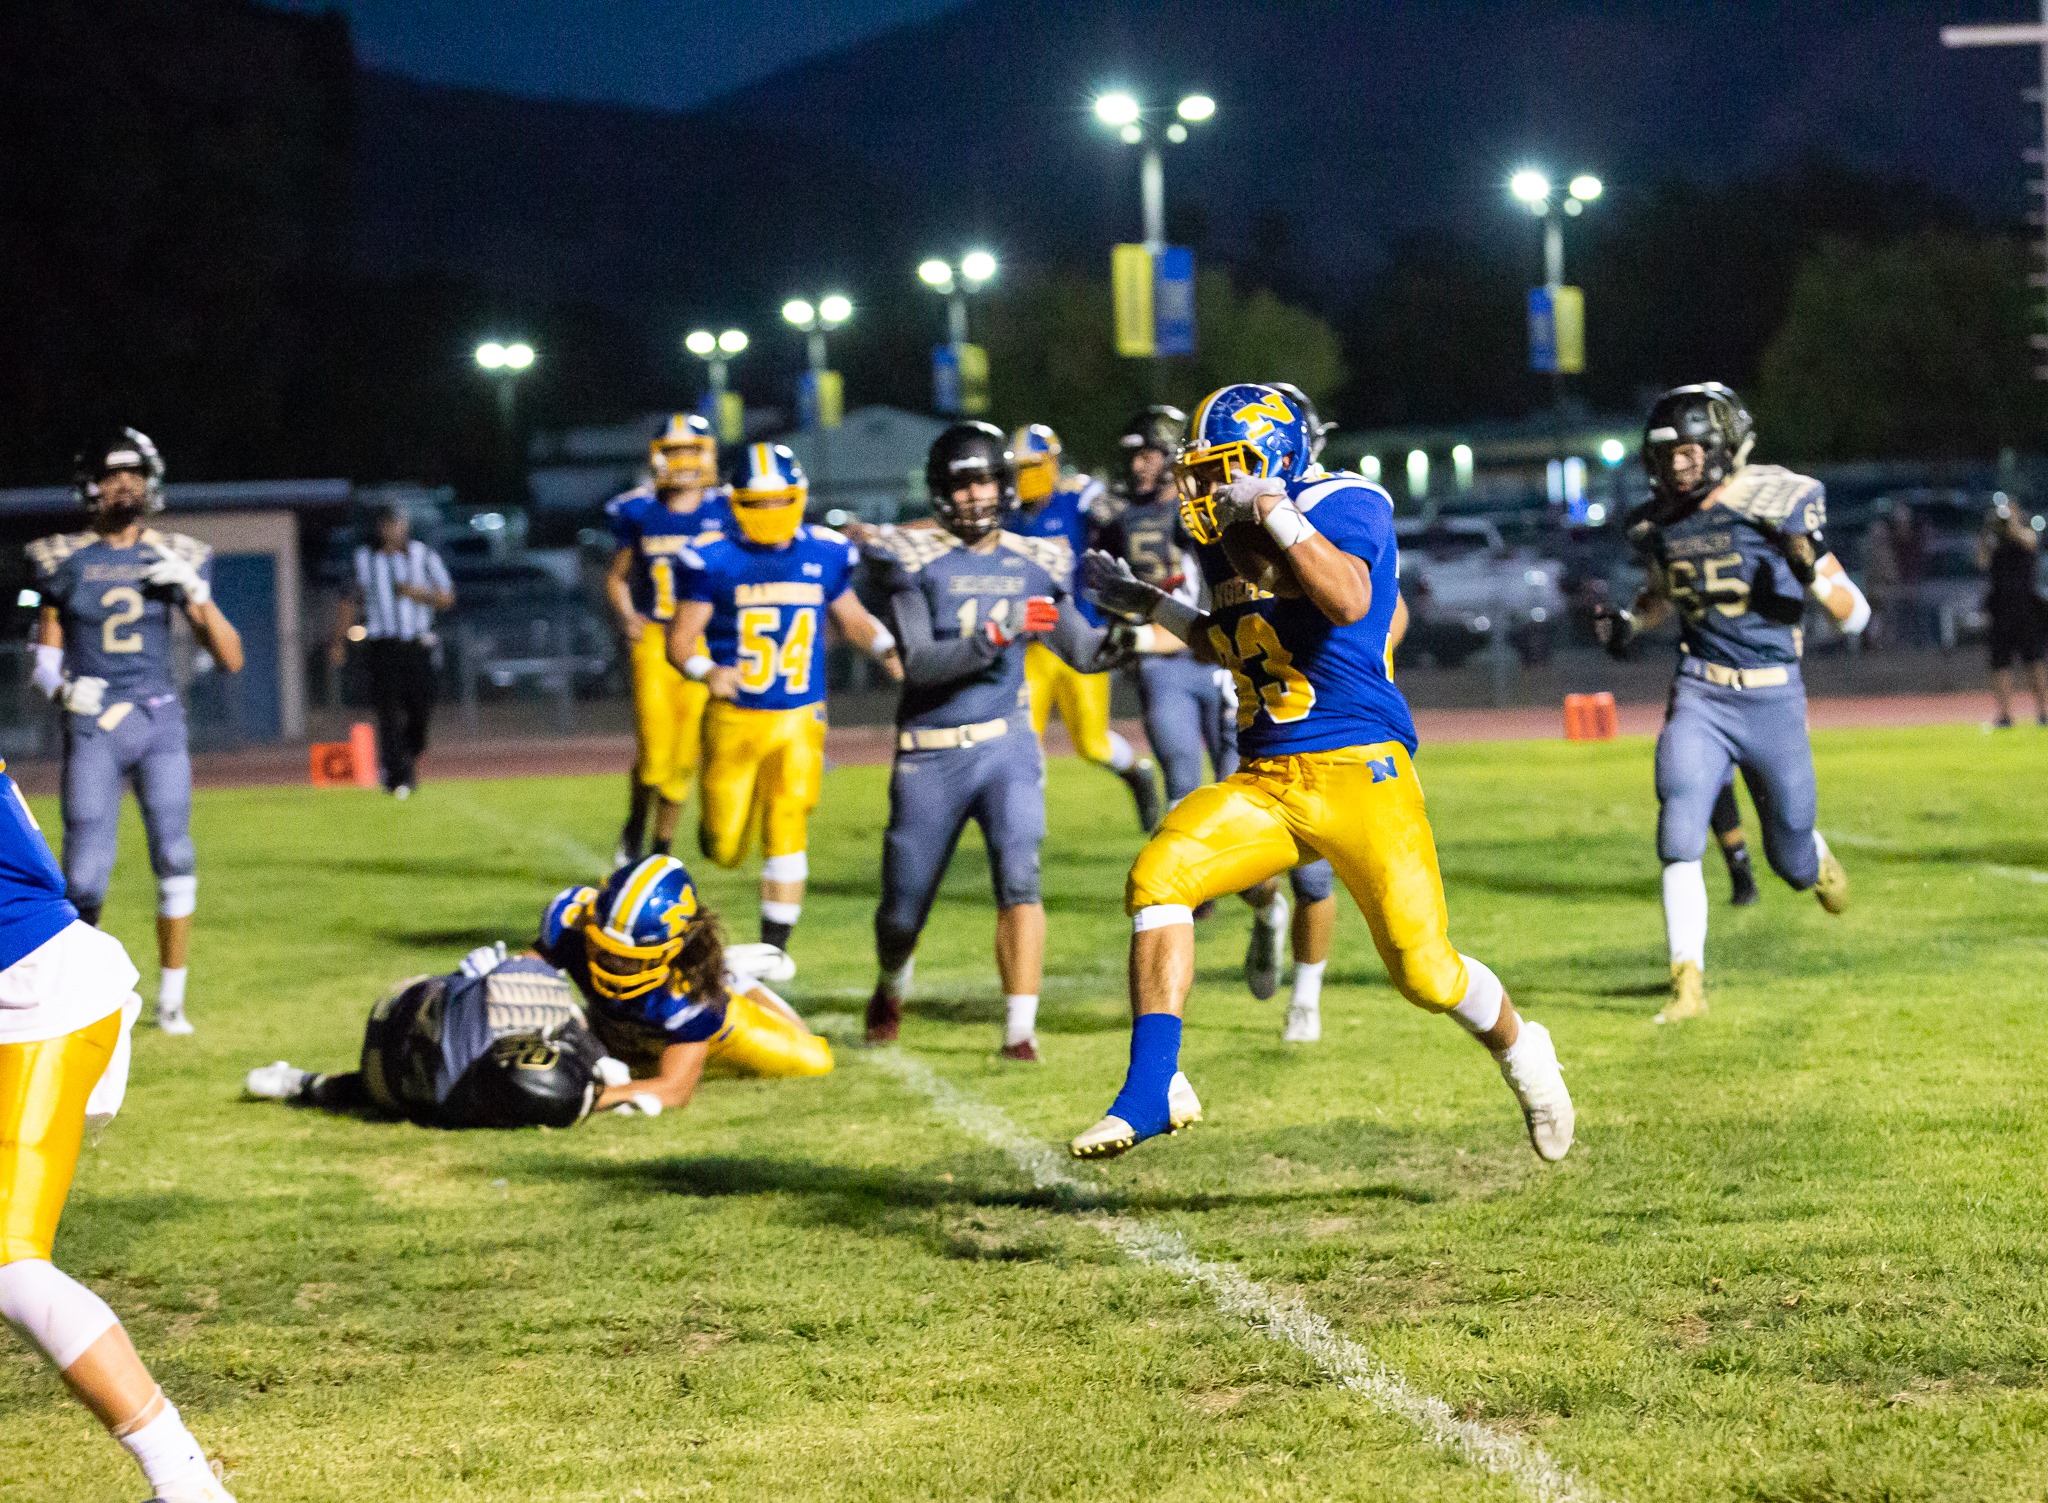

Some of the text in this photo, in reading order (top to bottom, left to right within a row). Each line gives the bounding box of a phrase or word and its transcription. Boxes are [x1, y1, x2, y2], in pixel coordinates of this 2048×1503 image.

[1231, 393, 1296, 440] N
[1668, 552, 1750, 619] 65
[101, 586, 144, 653] 2
[738, 607, 817, 694] 54
[1366, 755, 1399, 784] N
